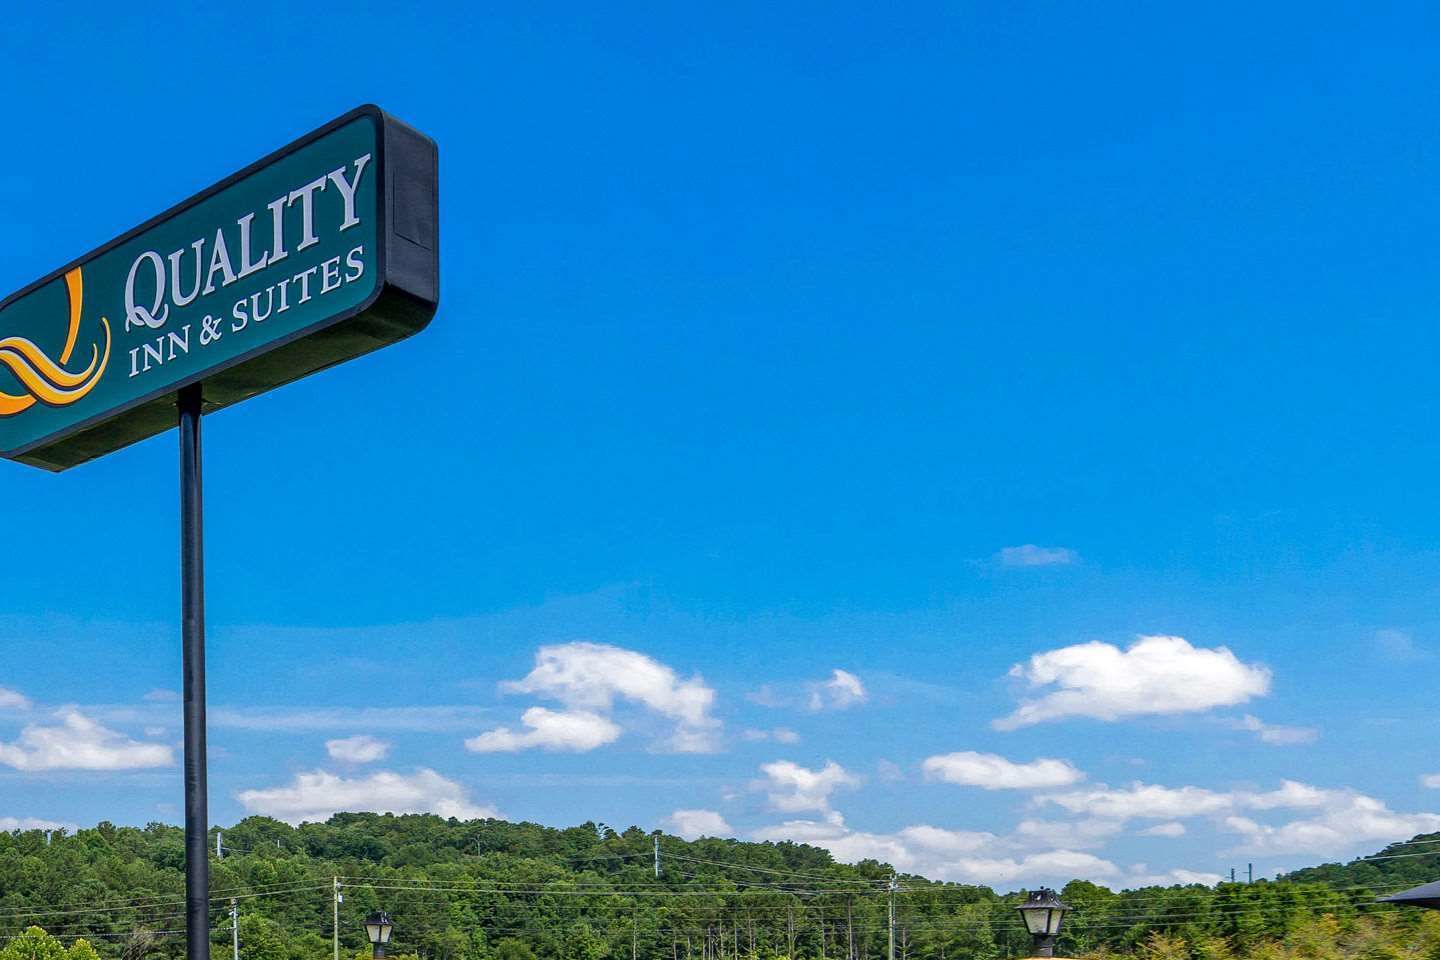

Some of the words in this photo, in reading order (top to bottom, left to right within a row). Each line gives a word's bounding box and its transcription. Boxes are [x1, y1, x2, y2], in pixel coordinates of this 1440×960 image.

[124, 153, 372, 332] QUALITY
[128, 325, 191, 378] INN
[199, 315, 223, 346] &
[231, 245, 364, 333] SUITES
